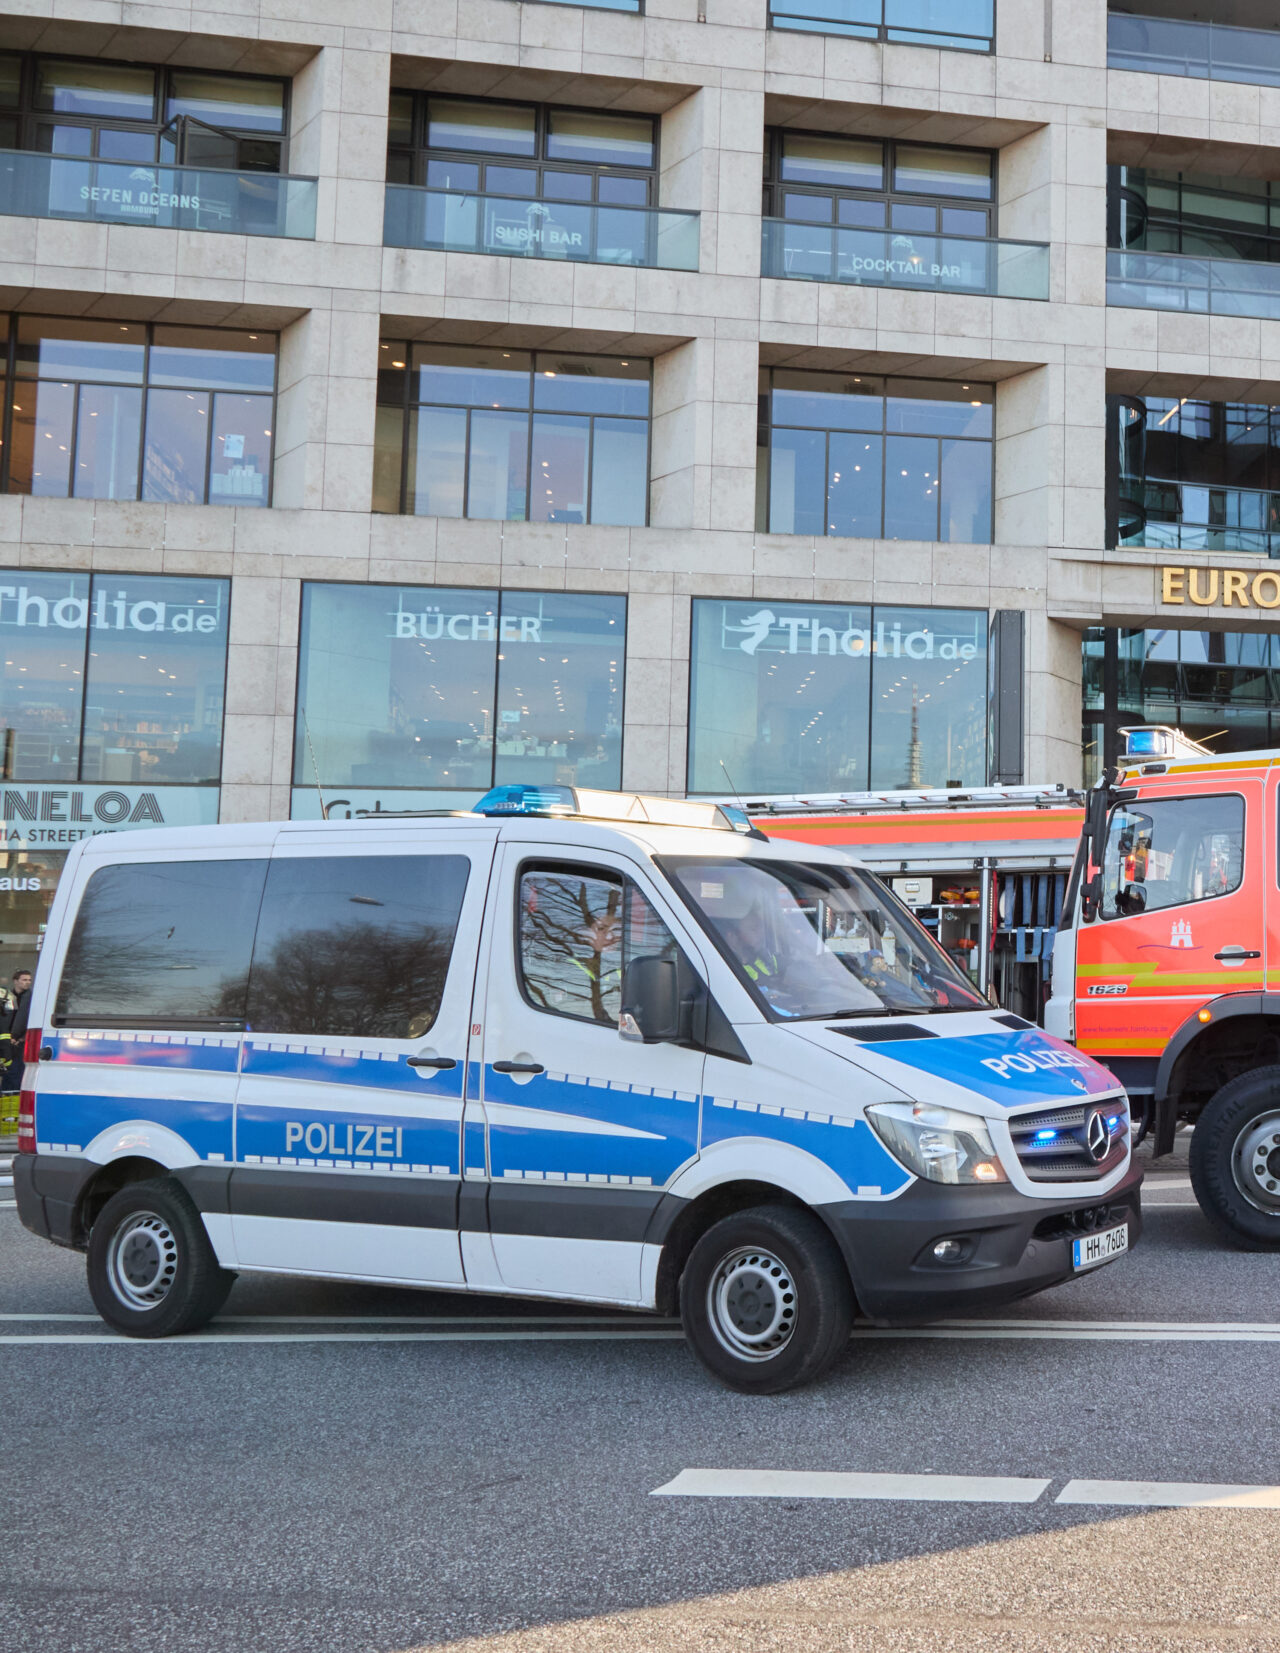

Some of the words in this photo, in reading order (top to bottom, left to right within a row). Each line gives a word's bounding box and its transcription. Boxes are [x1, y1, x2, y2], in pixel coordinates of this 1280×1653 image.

[80, 186, 132, 203] SE7EN
[140, 191, 200, 209] OCEANS
[495, 226, 544, 242] SUSHI
[550, 231, 582, 246] BAR
[852, 257, 927, 275] COCKTAIL
[931, 264, 961, 277] BAR
[396, 606, 541, 643] BÜCHER
[0, 790, 165, 823] NELOA
[0, 829, 21, 841] IA
[28, 829, 87, 842] STREET
[1088, 985, 1127, 995] 1629
[980, 1050, 1090, 1080] POLIZEI
[285, 1122, 402, 1158] POLIZEI
[1086, 1237, 1100, 1260] HH
